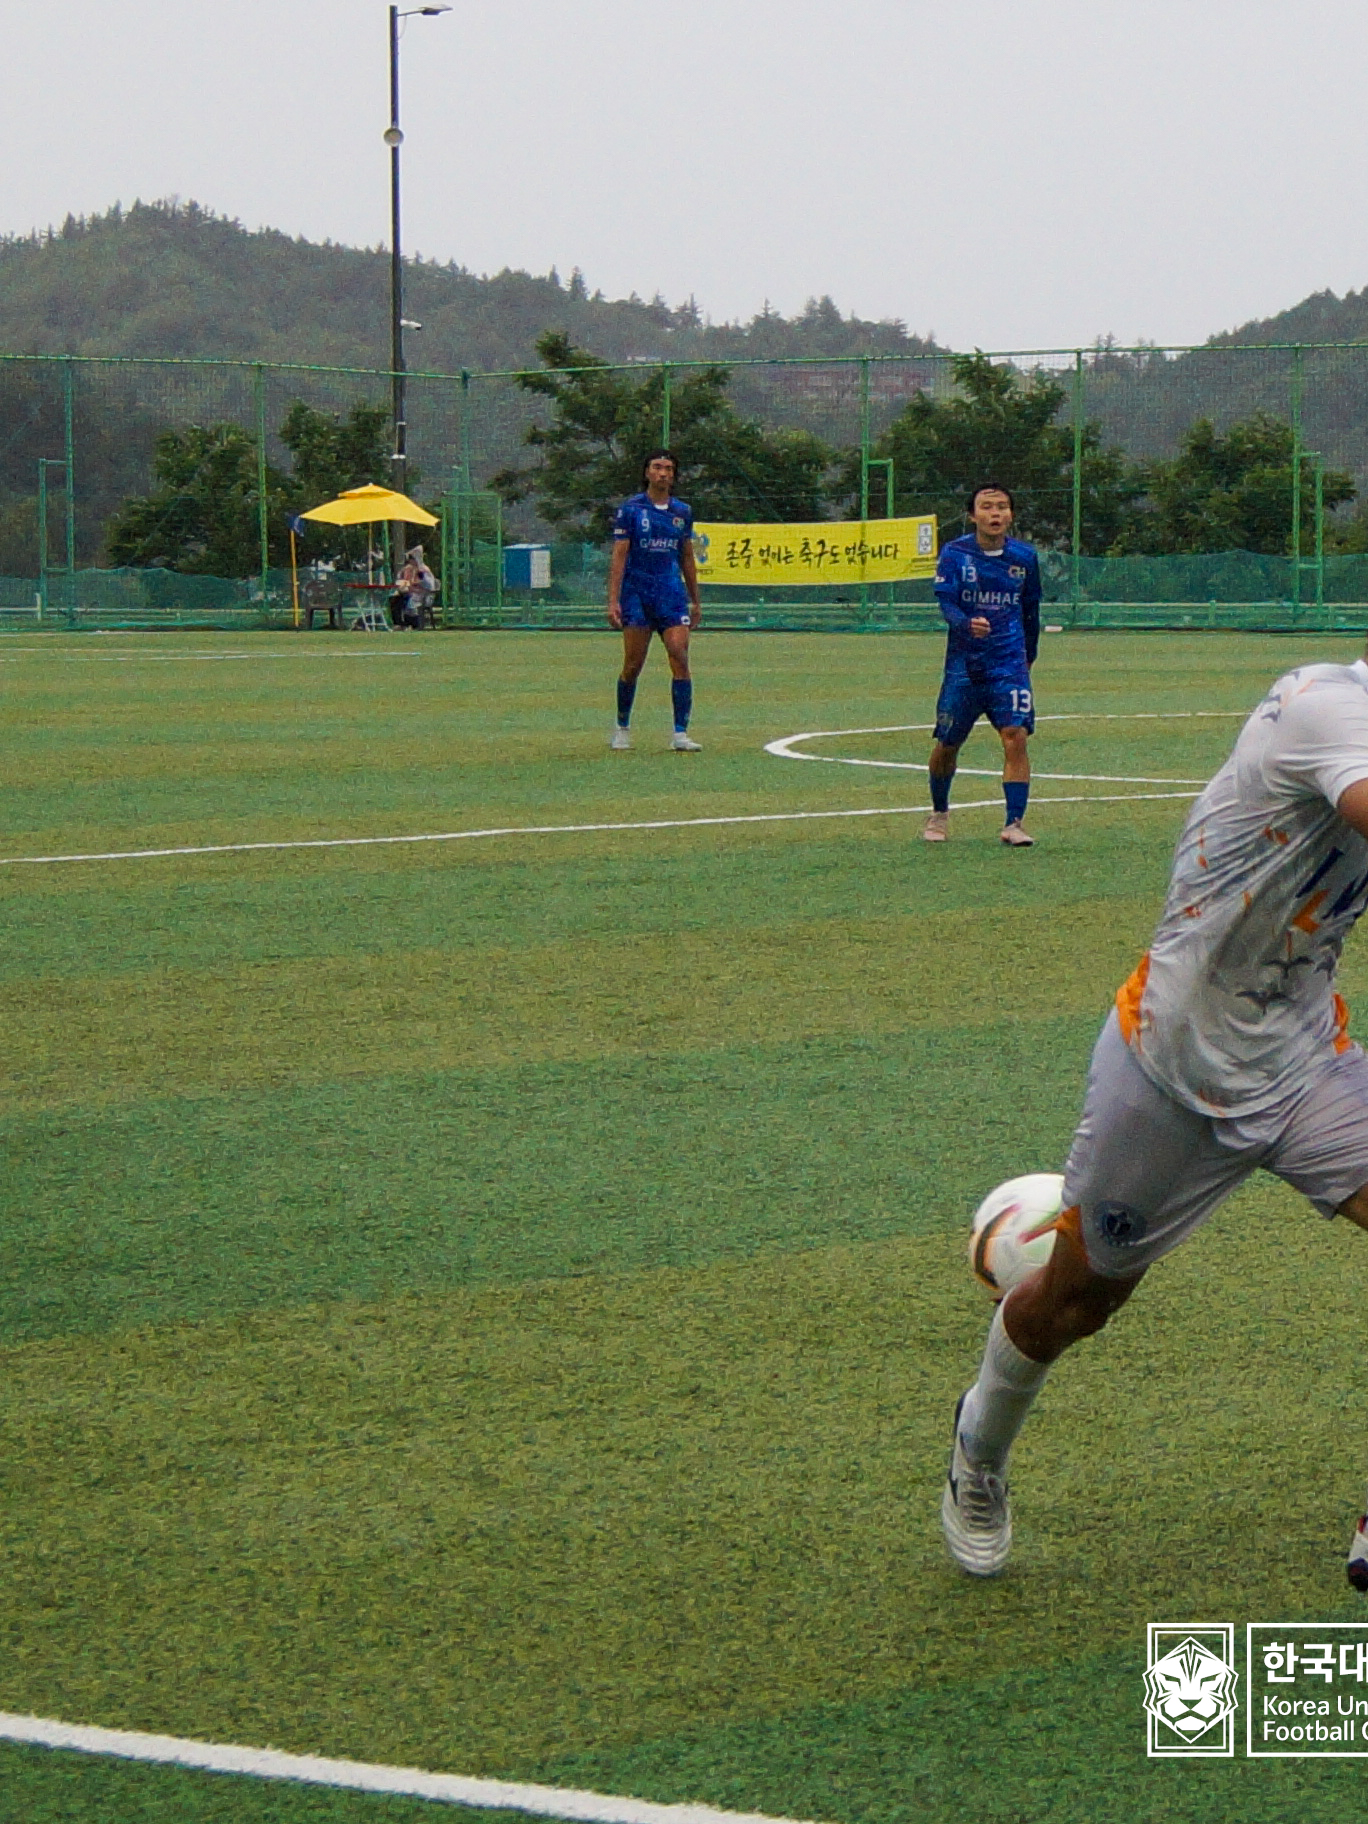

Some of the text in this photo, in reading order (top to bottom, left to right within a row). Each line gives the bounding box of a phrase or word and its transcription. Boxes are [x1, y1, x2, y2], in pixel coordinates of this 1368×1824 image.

[641, 517, 650, 532] 9
[726, 538, 753, 569] 존중
[799, 537, 840, 569] 축구도
[844, 540, 900, 570] 없습니다
[961, 566, 977, 582] 13
[961, 588, 1021, 606] GIMHAE
[1010, 688, 1032, 713] 13
